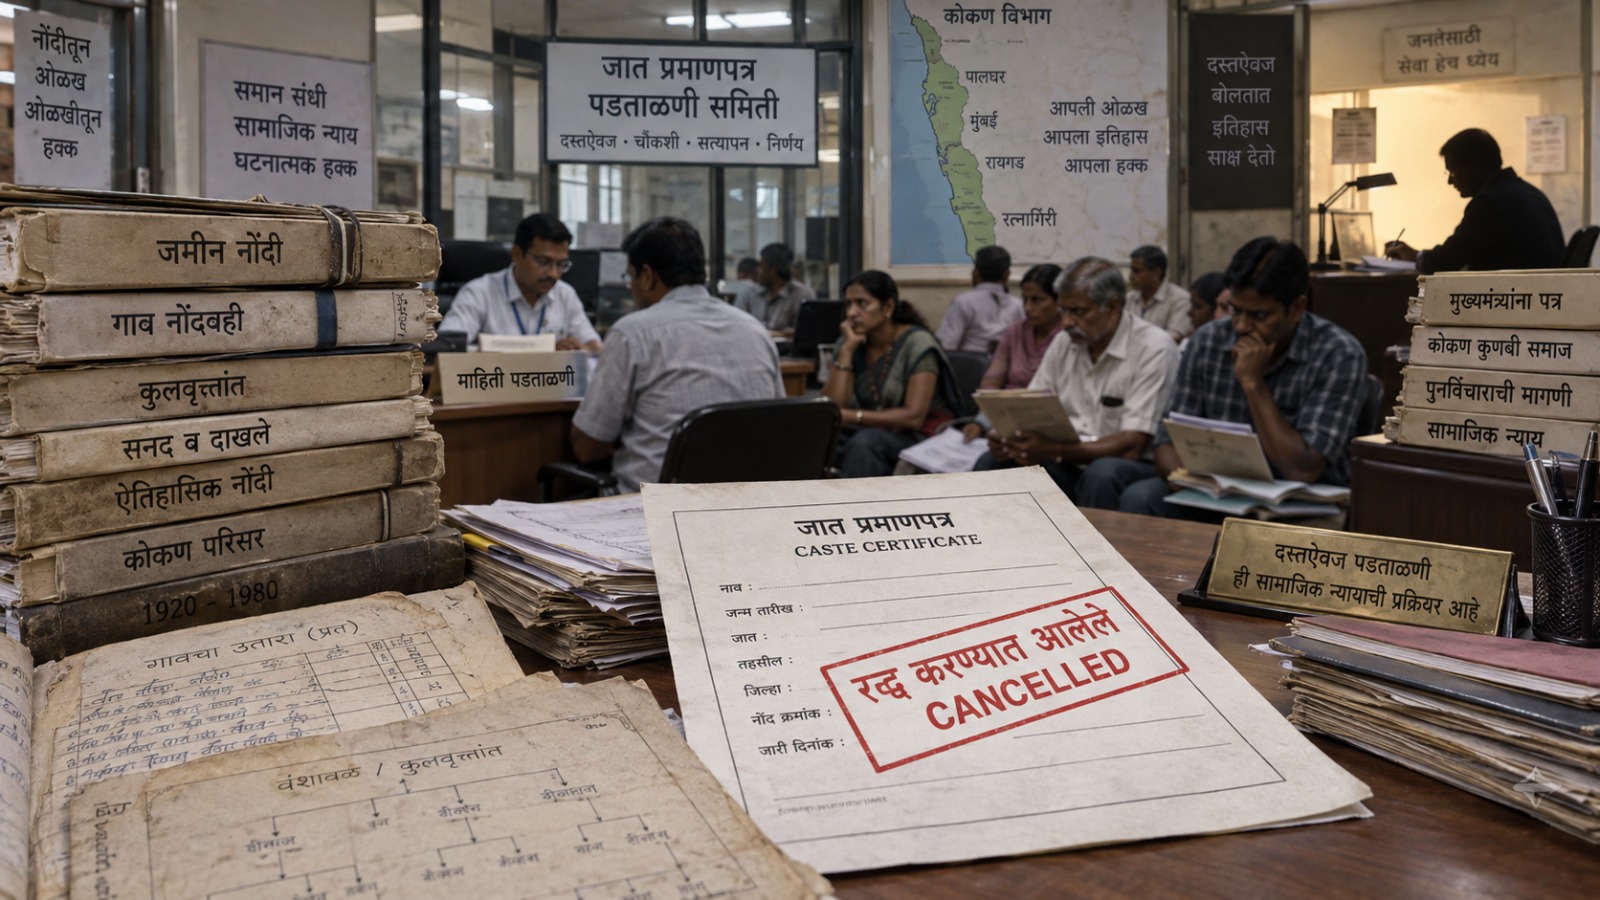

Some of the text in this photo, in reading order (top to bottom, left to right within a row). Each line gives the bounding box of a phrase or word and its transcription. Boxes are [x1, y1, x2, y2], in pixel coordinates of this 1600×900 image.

[944, 3, 1052, 24] कोकण विभाग
[32, 24, 90, 63] नोंदीतून
[1407, 24, 1482, 48] जनतेसाठी
[602, 56, 757, 81] जात प्रमाणपत्र
[1206, 51, 1276, 76] दस्तऐवज
[1398, 54, 1428, 74] सेवा
[1466, 49, 1500, 68] ध्येय
[35, 61, 86, 92] ओळख
[965, 70, 1006, 84] पालघर
[234, 80, 327, 109] समान संधी
[588, 87, 780, 120] पडताळणी समिती
[1211, 82, 1272, 104] बोलतात
[25, 96, 102, 134] ओळखीतून
[1050, 96, 1148, 116] आपली ओळख
[234, 113, 358, 146] सामाजिक न्याय
[1043, 125, 1148, 146] आपला इतिहास
[1212, 114, 1270, 139] इतिहास
[42, 136, 78, 160] हक्क
[560, 130, 617, 150] दस्तऐवज
[697, 136, 749, 150] सत्यापन
[766, 132, 804, 152] निर्णय
[234, 152, 358, 178] घटनात्मक हक्क
[986, 156, 1026, 170] रायगड
[1065, 159, 1148, 175] आपला हक्क
[1207, 144, 1276, 167] साक्ष देतो
[157, 230, 284, 266] जमीन नोंदी
[1450, 288, 1563, 315] मुख्यमंत्र्यांना पत्र
[111, 302, 244, 336] गाव नोंदवही
[1428, 332, 1573, 361] कोकण कुणबी समाज
[138, 370, 246, 410] कुलवृत्तांत
[458, 365, 575, 391] माहिती पडताळणी
[1522, 382, 1573, 408] मागणी
[122, 435, 174, 460] सनद
[210, 418, 271, 452] दाखले
[1428, 418, 1544, 448] सामाजिक न्याय
[115, 464, 274, 515] ऐतिहासिक नोंदी
[794, 512, 955, 536] जात प्रमाणपत्र
[122, 526, 266, 572] कोकण परिसर
[794, 534, 982, 558] CASTE CERTIFICATE
[1275, 542, 1432, 580] दस्तऐवज पडताळणी
[720, 583, 742, 594] नाव
[1233, 566, 1250, 588] ही
[1256, 573, 1324, 598] सामाजिक
[1330, 584, 1387, 608] न्यायाची
[1449, 597, 1480, 623] आहे
[143, 595, 196, 626] 1920
[228, 580, 278, 609] 1980
[726, 607, 752, 618] जन्म
[756, 603, 794, 616] तारीख
[144, 620, 358, 669] गावचा उतारा (प्रत)
[731, 632, 757, 644] जात
[908, 634, 1028, 686] करण्यात
[1031, 602, 1120, 652] आलेले
[737, 655, 782, 670] तहसील
[744, 684, 782, 697] जिल्हा
[926, 648, 1130, 730] CANCELLED
[751, 712, 776, 726] नोंद
[780, 708, 820, 722] क्रमांक
[758, 741, 788, 756] जारी
[792, 738, 834, 753] दिनांक
[276, 766, 362, 791] वंशावळ
